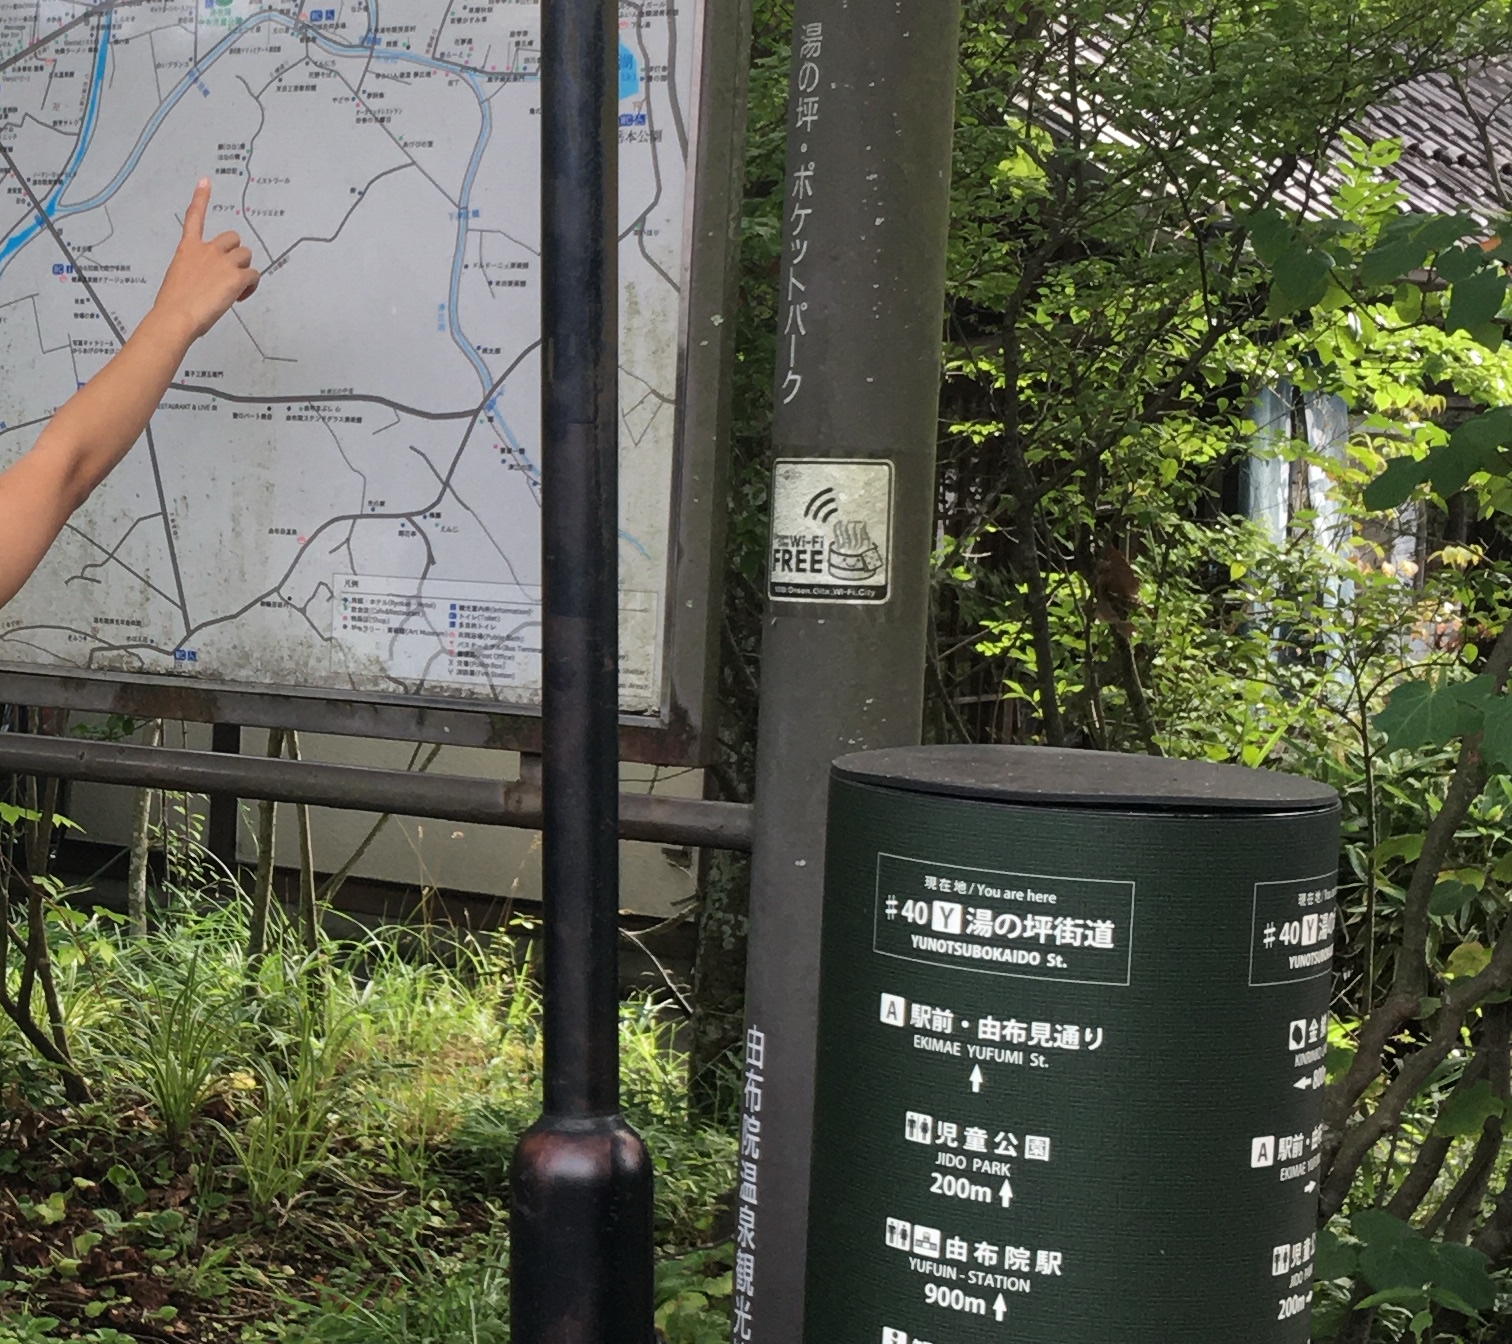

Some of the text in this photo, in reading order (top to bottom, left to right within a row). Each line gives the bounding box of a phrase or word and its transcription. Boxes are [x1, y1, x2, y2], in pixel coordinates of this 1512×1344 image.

[781, 21, 824, 406] 湯の坪・ポケットパーク
[772, 548, 824, 574] FREE
[1003, 889, 1024, 902] are
[1026, 888, 1057, 904] here
[965, 905, 1116, 949] 湯の坪街道
[910, 933, 1068, 969] YUNOTSUBOKAIDO St.
[909, 1002, 1103, 1050] 駅前・由布見通り
[913, 1034, 1049, 1069] EKIMAE YUFUMI St.
[934, 1120, 1051, 1162] 児童公園
[935, 1151, 1011, 1177] JIDO PARK
[929, 1172, 992, 1204] 200m
[945, 1235, 1062, 1277] 由布院駅
[923, 1282, 986, 1316] 900m
